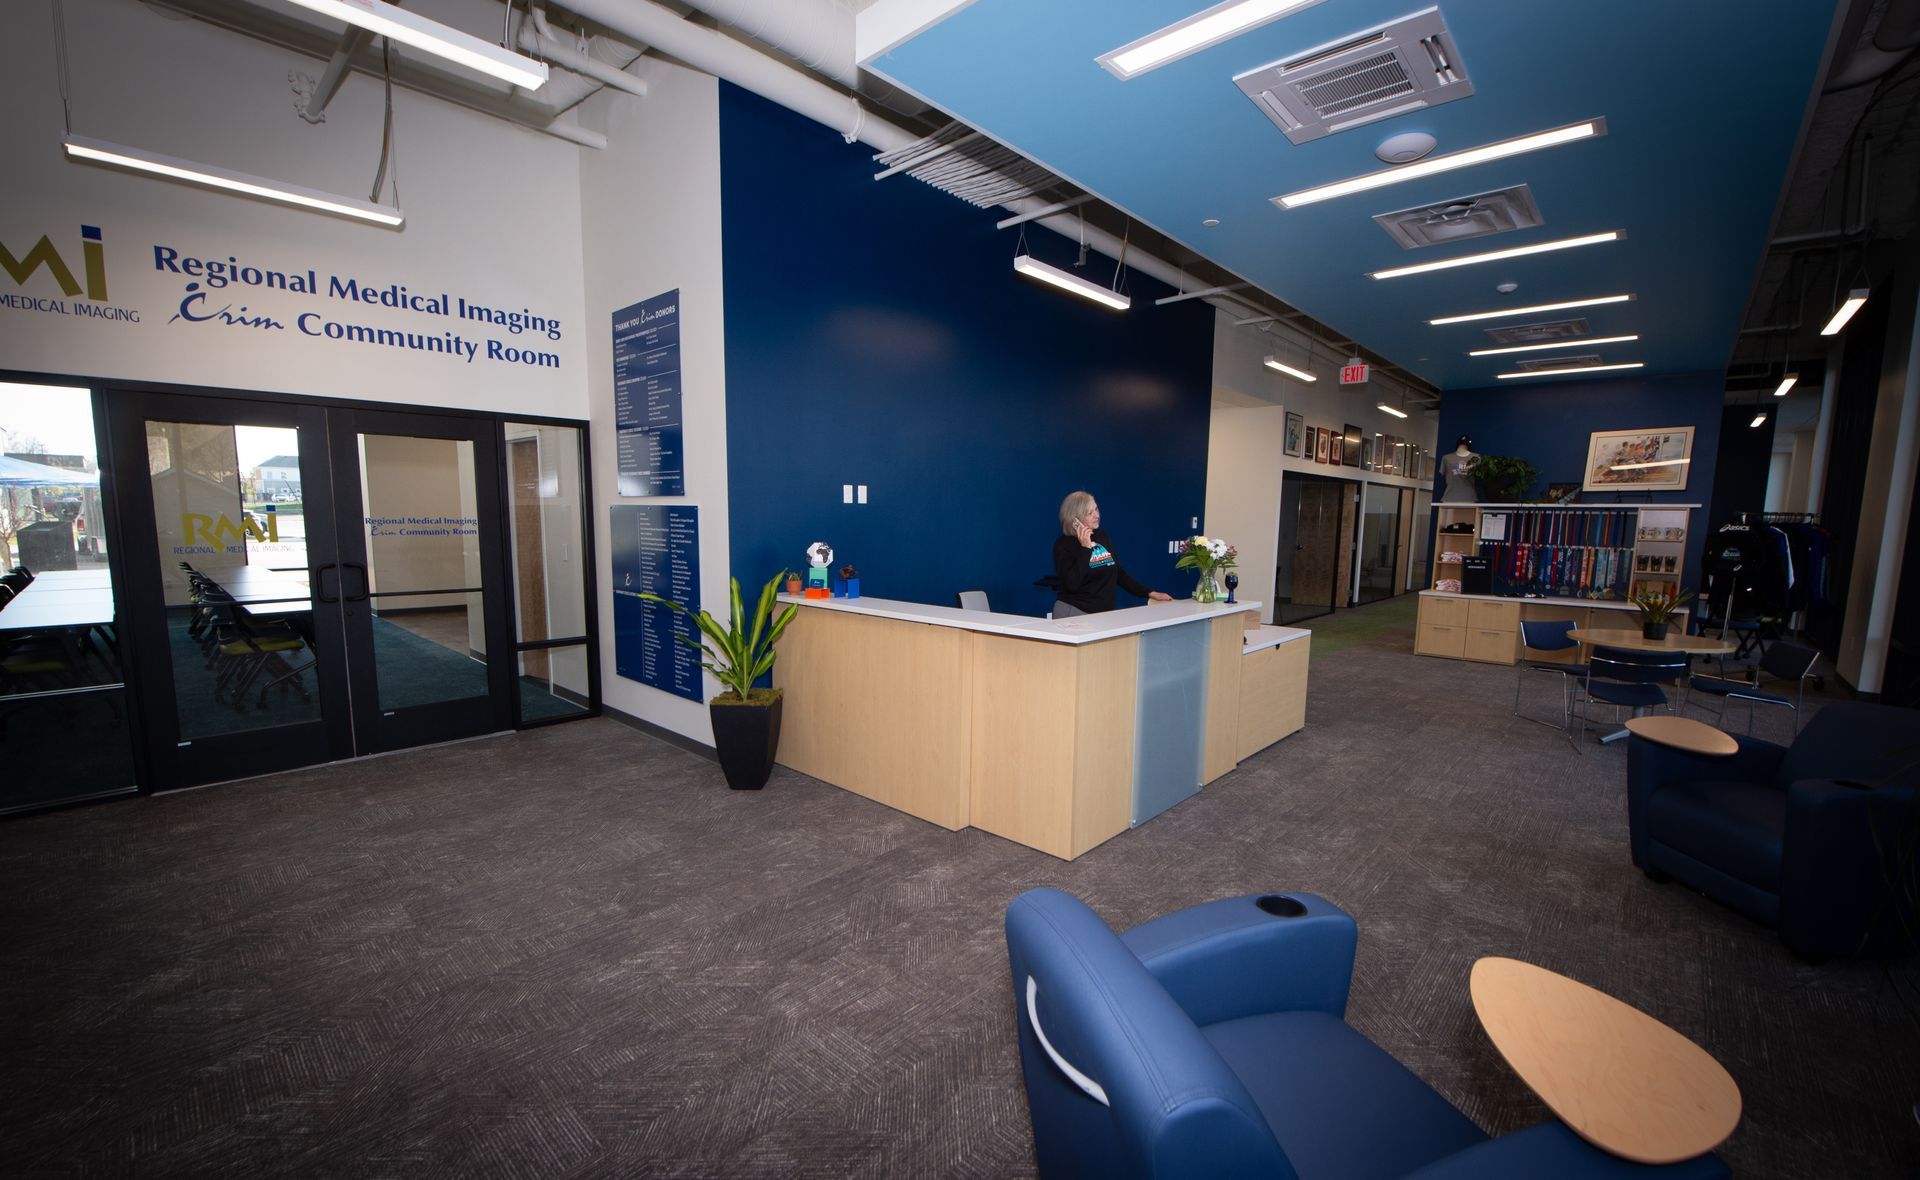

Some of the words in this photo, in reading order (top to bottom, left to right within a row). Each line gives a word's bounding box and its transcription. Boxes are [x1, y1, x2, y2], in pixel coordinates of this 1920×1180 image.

[154, 245, 317, 294] Regional
[328, 275, 449, 316] Medical
[458, 298, 562, 340] Imaging
[74, 303, 140, 323] IMAGING
[615, 320, 630, 332] THANK
[630, 318, 640, 327] YOU
[655, 305, 676, 318] DONORS
[168, 282, 284, 330] Crim
[297, 312, 479, 363] Community
[487, 340, 560, 368] Room
[1344, 365, 1365, 383] EXIT
[365, 517, 405, 526] Regional
[407, 517, 442, 525] Medical
[444, 518, 478, 526] Imaging
[399, 528, 451, 536] Community
[173, 545, 216, 555] REGIONAL
[226, 544, 260, 553] MEDIAL
